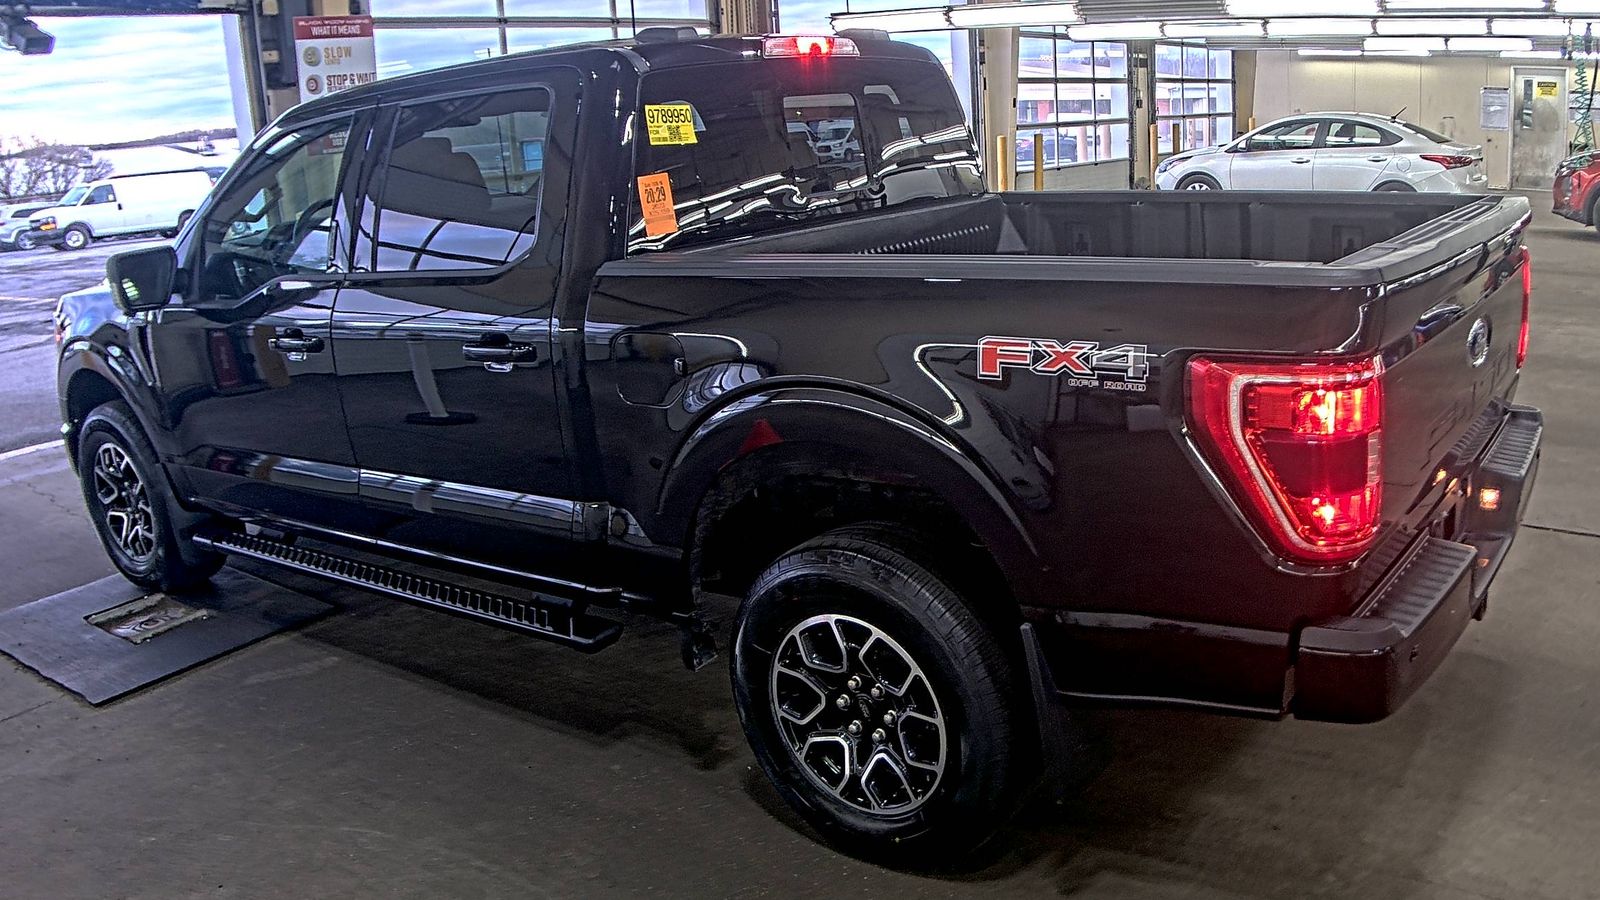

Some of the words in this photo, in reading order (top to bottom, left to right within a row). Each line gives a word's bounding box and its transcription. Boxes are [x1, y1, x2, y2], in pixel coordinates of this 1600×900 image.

[311, 25, 330, 36] WHAT
[331, 25, 338, 35] IT
[338, 24, 361, 35] MEANS
[324, 46, 352, 58] SLOW
[326, 74, 348, 86] STOP
[348, 73, 356, 85] &
[356, 71, 376, 84] WAIT
[647, 108, 692, 124] 9789950
[977, 335, 1149, 382] FX4
[1067, 378, 1099, 387] OFF
[1103, 380, 1147, 392] ROAD
